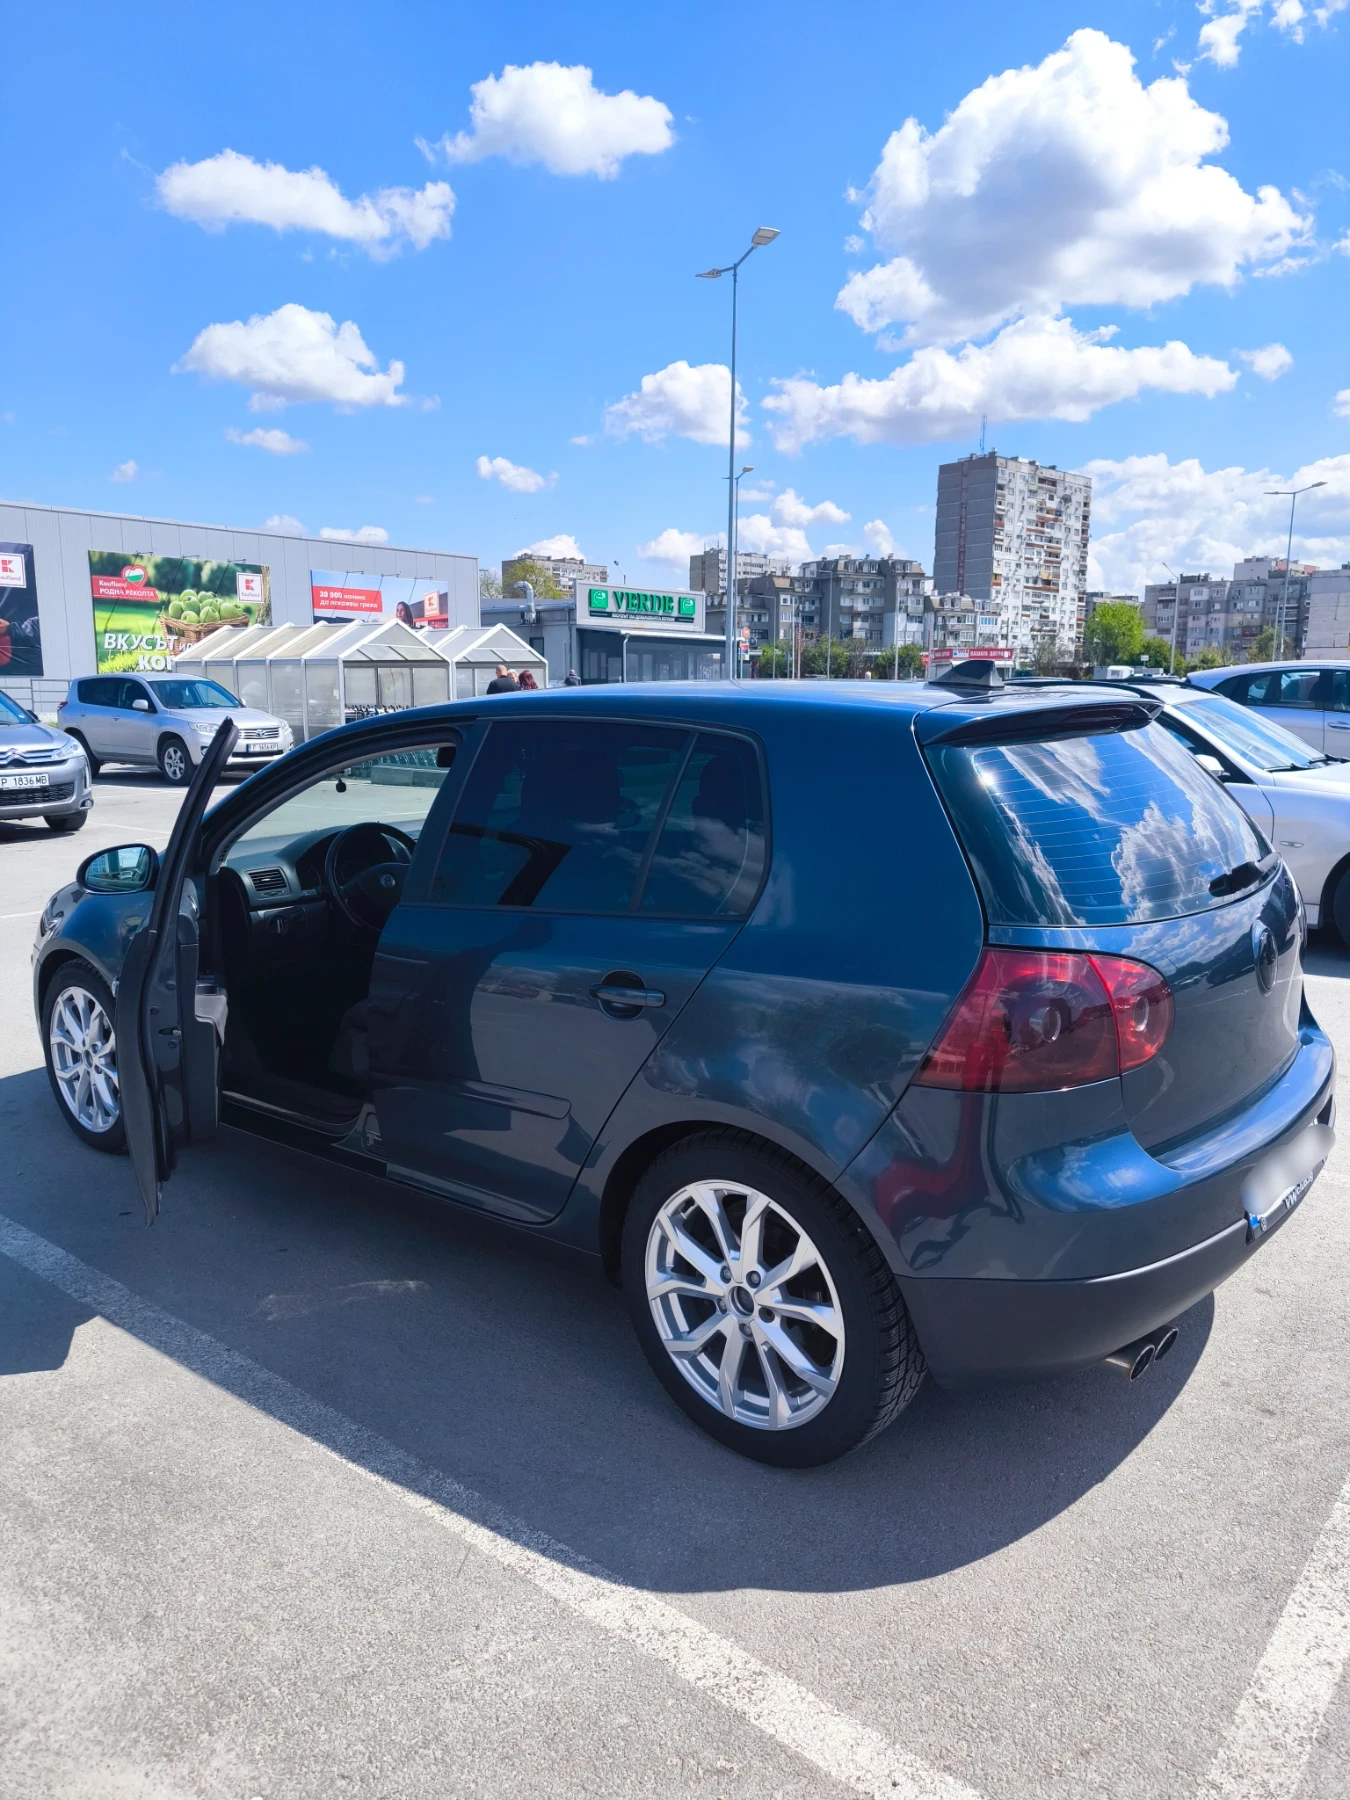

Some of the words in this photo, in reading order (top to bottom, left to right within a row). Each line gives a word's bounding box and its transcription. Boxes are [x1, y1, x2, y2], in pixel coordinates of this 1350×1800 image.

[612, 591, 674, 613] VERDE
[104, 632, 178, 651] ВКУСЪТ
[13, 777, 34, 786] 1836
